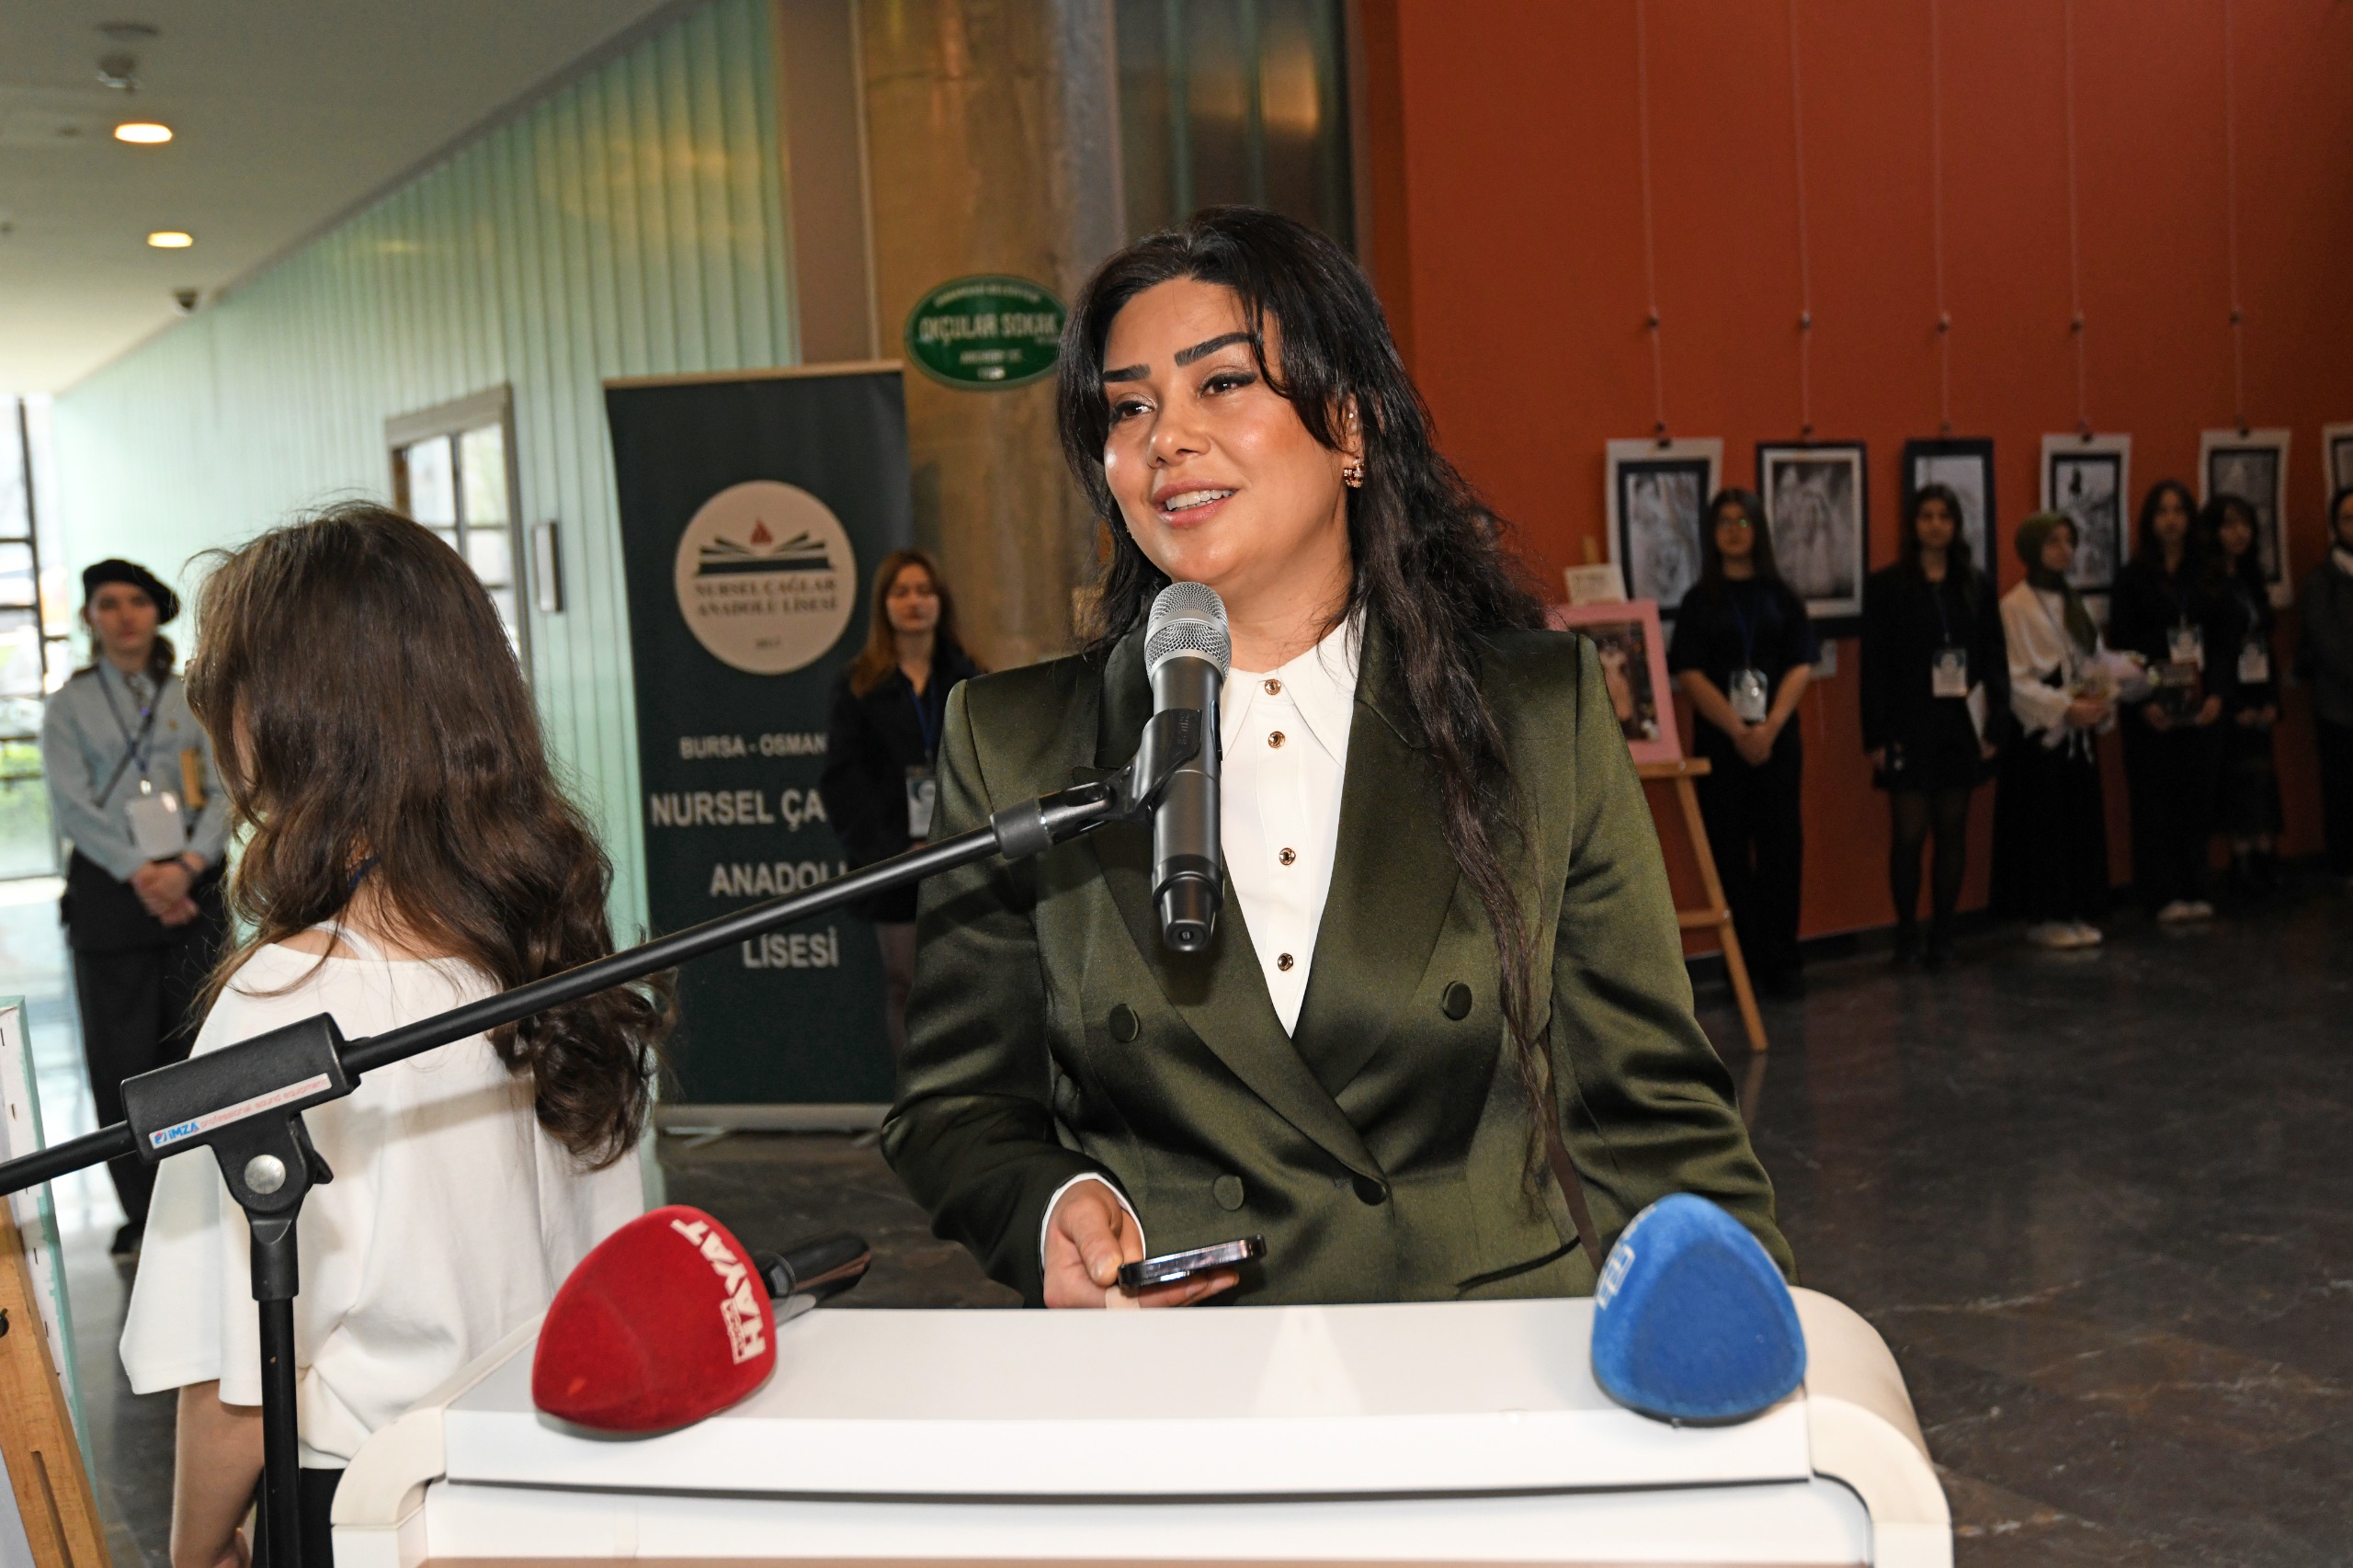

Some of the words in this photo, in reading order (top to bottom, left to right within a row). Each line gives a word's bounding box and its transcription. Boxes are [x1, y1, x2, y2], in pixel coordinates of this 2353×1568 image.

[679, 736, 746, 760] BURSA
[759, 733, 827, 756] OSMAN
[651, 790, 775, 826] NURSEL
[782, 788, 827, 832] ÇA
[710, 861, 848, 897] ANADO
[670, 1219, 767, 1362] HAYAT
